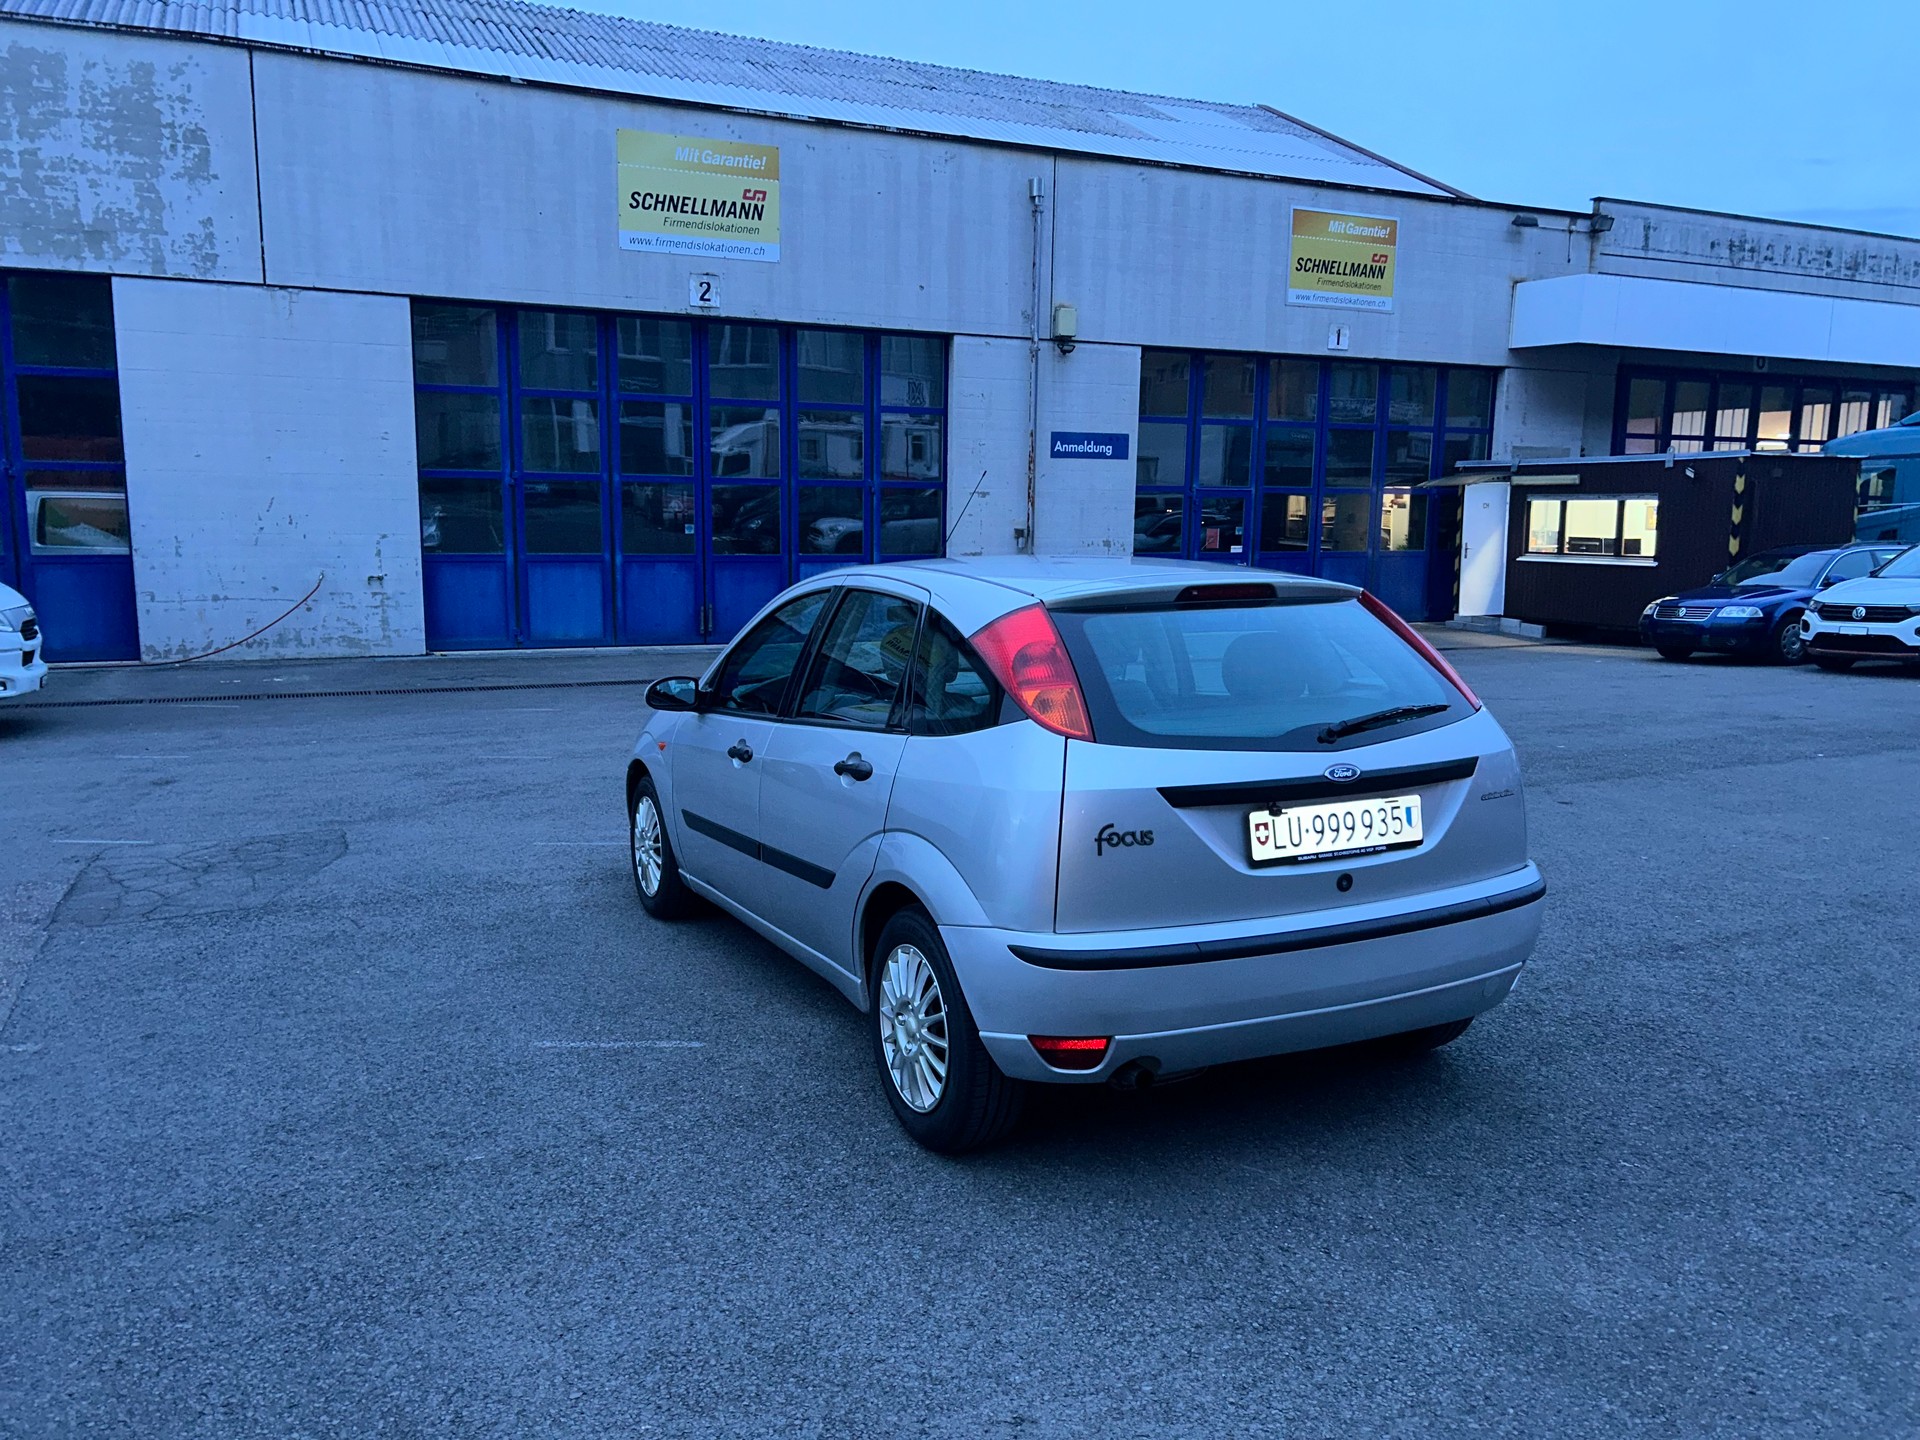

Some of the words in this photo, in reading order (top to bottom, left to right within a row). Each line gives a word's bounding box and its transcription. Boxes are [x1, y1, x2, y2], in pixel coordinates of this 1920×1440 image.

[675, 147, 699, 163] Mit
[702, 150, 767, 170] Garantie!
[629, 191, 765, 221] SCHNELLMANN
[663, 217, 760, 235] Firmendislokationen
[1328, 220, 1345, 233] Mit
[1346, 222, 1390, 239] Garantie!
[629, 236, 766, 256] www.firmendislokationen.ch
[1295, 256, 1386, 279] SCHNELLMANN
[699, 281, 711, 302] 2
[1316, 277, 1382, 291] Firmendislokationen
[1295, 292, 1386, 307] www.firmendislokationen.ch
[1053, 440, 1113, 456] Anmeldung
[1333, 768, 1352, 778] Ford
